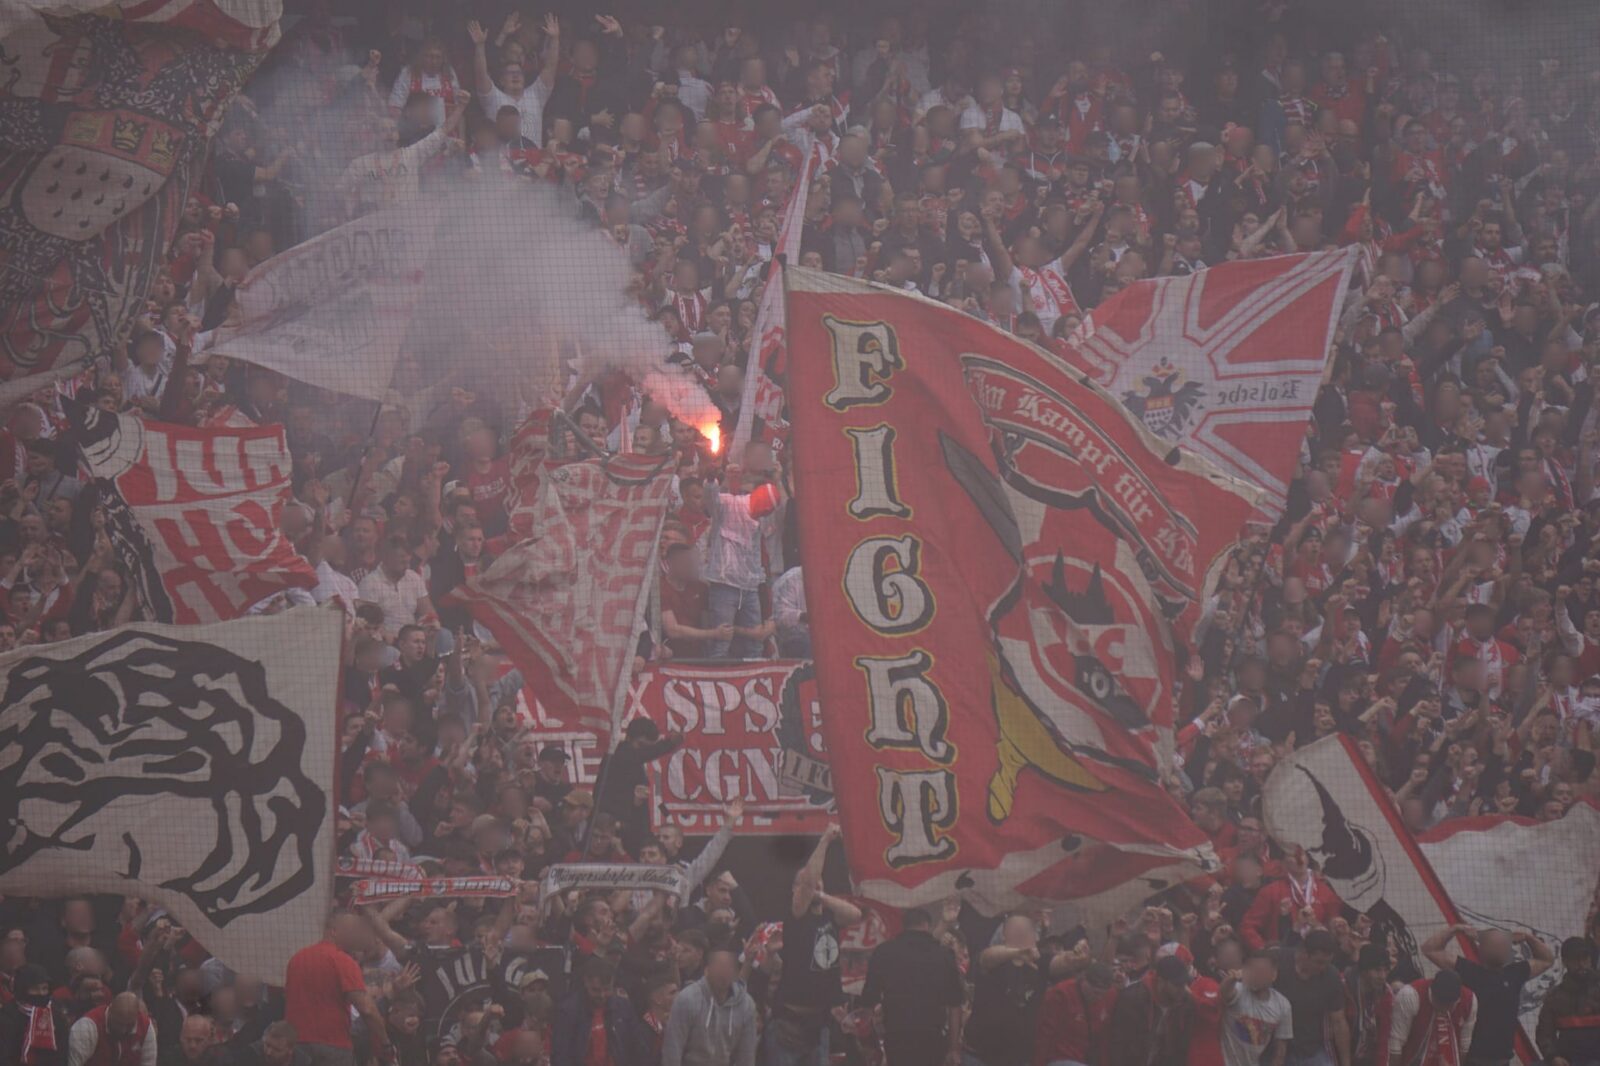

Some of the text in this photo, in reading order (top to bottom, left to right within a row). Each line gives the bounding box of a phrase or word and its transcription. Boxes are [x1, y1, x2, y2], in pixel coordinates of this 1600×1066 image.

[1013, 387, 1119, 475] Kampf
[663, 677, 779, 735] SPS
[667, 748, 784, 802] CGN
